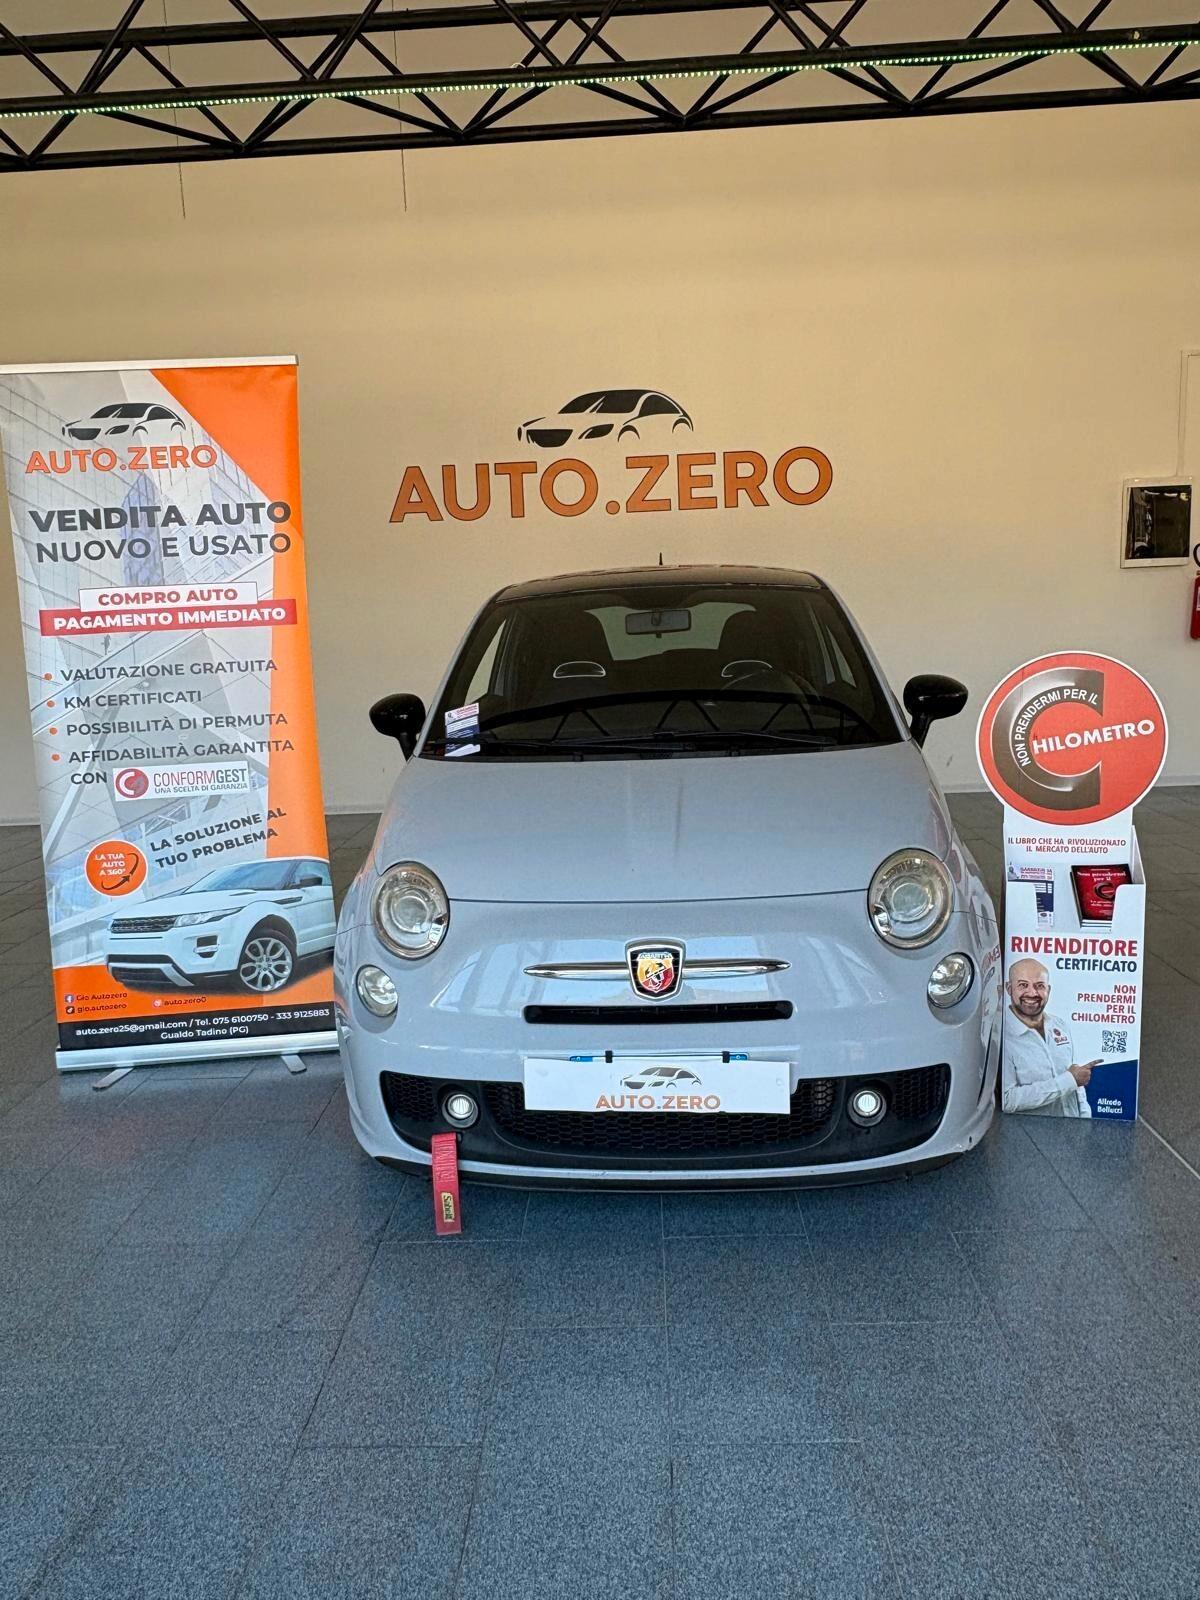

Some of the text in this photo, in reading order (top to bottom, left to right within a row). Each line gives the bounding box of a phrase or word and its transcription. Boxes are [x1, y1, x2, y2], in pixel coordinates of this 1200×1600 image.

[25, 444, 217, 474] AUTO.ZERO
[389, 446, 833, 524] AUTO.ZERO
[29, 501, 291, 533] VENDITA AUTO
[37, 533, 291, 563] NUOVO E USATO
[98, 588, 239, 607] COMPRO AUTO
[54, 607, 286, 631] PAGAMENTO IMMEDIATO
[60, 659, 278, 682] VALUTAZIONE GRATUITA
[64, 690, 202, 709] KM CERTIFICATI
[67, 713, 288, 736] POSSIBILITÀ DI PERMUTA
[1014, 688, 1099, 767] NON PRENDERMI PER IL
[69, 739, 294, 763] AFFIDABILITÀ GARANTITA
[71, 772, 107, 785] CON
[153, 768, 247, 788] CONFORMGEST
[173, 785, 200, 793] SCELTA
[210, 782, 248, 791] GARANZIA
[150, 807, 287, 852] LA SOLUZIONE AL
[155, 828, 278, 869] TUO PROBLEMA
[1016, 837, 1036, 845] LIBRO
[1071, 846, 1108, 854] DELL'AUTO
[102, 860, 125, 868] AUTO
[1011, 936, 1138, 957] RIVENDITORE
[1056, 958, 1137, 972] CERTIFICATO
[91, 992, 128, 1001] Autozero
[1078, 993, 1136, 1004] PRENDERMI
[1114, 985, 1136, 994] NON
[77, 1003, 127, 1014] gio.autozero
[1071, 1012, 1135, 1024] CHILOMETRO
[1106, 1004, 1136, 1014] PER IL
[75, 1021, 188, 1036] auto.zero25@gmail.com
[195, 1018, 211, 1026] Tel.
[212, 1017, 230, 1025] 075
[232, 1014, 269, 1024] 6100750
[276, 1012, 292, 1020] 333
[294, 1009, 330, 1019] 9125883
[160, 1026, 249, 1039] Gualdo Tadino (PG)
[595, 1094, 721, 1110] AUTO.ZERO
